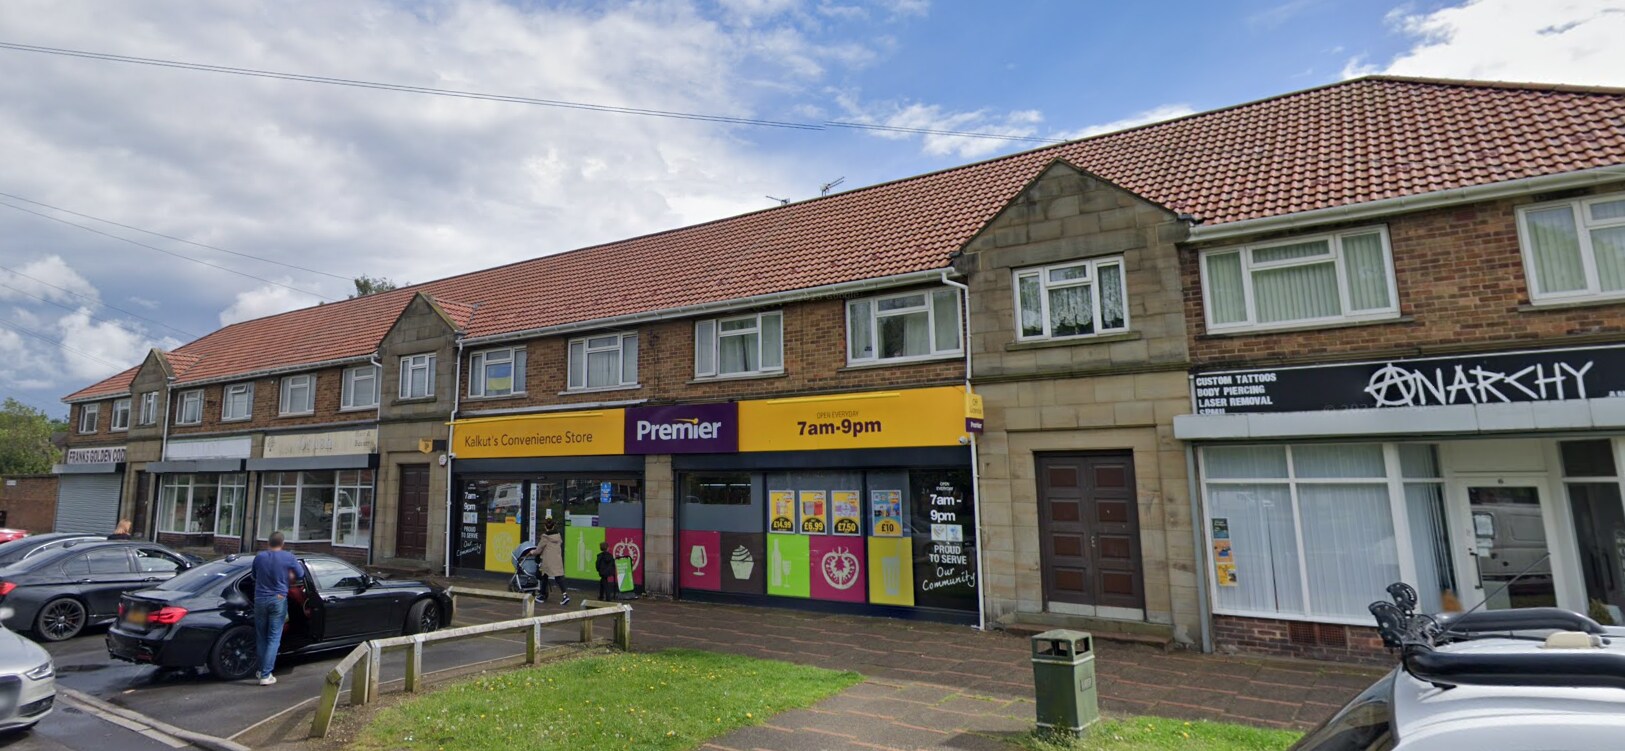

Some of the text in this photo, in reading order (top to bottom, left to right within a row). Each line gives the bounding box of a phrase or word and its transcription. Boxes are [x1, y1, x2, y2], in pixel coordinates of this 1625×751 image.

[1196, 373, 1277, 386] CUSTOM TATTOOS
[1364, 361, 1593, 408] ANARCHY
[1197, 385, 1266, 397] BODY PIERCING
[1198, 396, 1273, 408] LASER REMOVAL
[816, 410, 859, 419] OPEN EVERYDAY
[637, 418, 722, 441] Premier
[797, 418, 882, 437] 7am-9pm
[464, 431, 593, 447] Kalkut's Convenience Store
[69, 450, 90, 463] FRANKS
[90, 449, 112, 462] GOLDEN
[930, 494, 955, 506] 7am
[463, 502, 476, 511] 9pm
[930, 509, 956, 523] 9pm
[773, 521, 791, 529] £14.99
[803, 521, 824, 532] £6.99
[837, 522, 856, 532] £7.50
[881, 523, 895, 532] £10
[933, 544, 961, 555] PROUD
[928, 554, 968, 565] TO SERVE
[936, 566, 955, 577] Our
[922, 569, 976, 591] Community
